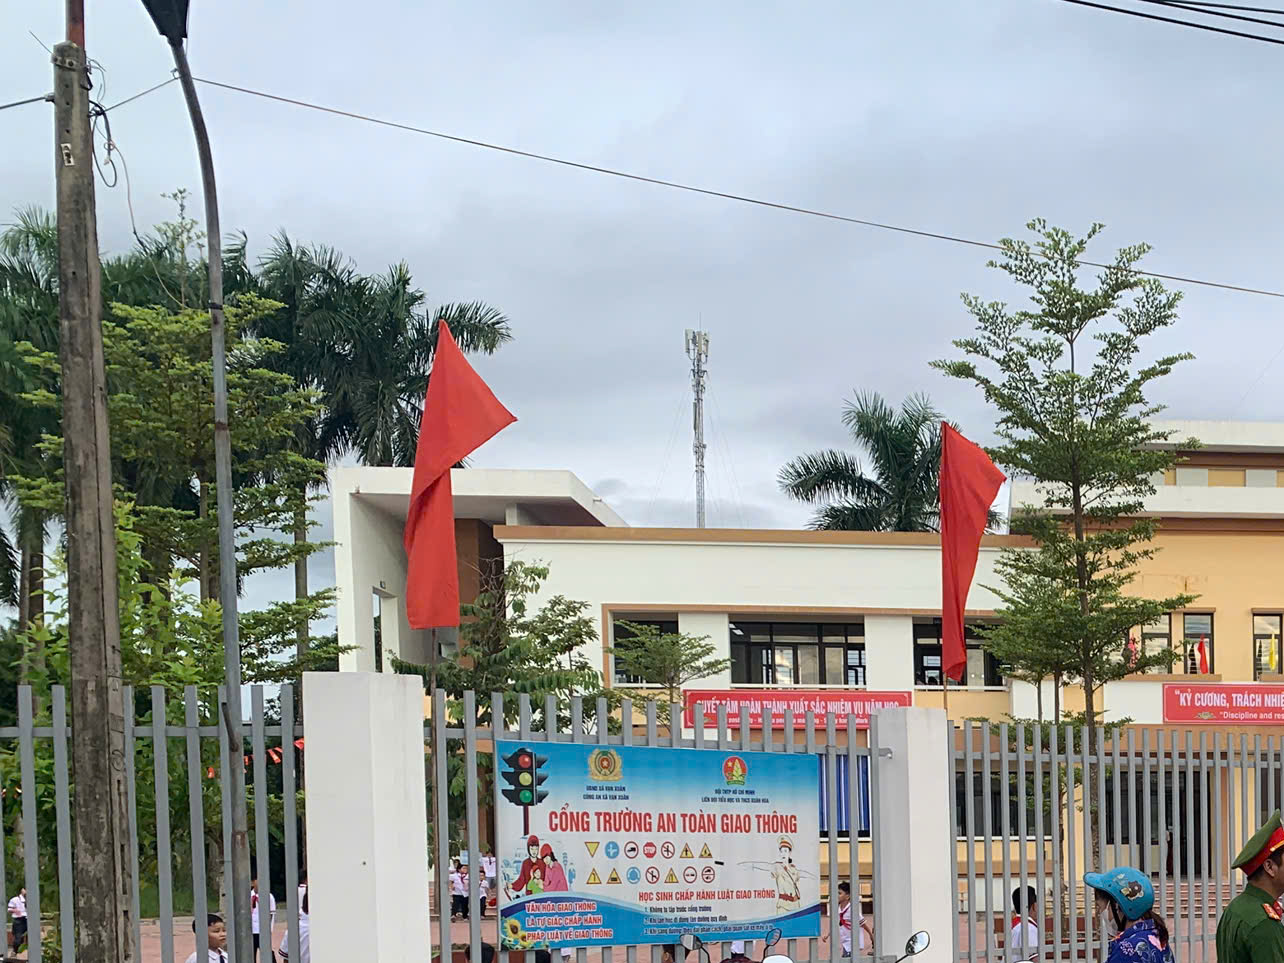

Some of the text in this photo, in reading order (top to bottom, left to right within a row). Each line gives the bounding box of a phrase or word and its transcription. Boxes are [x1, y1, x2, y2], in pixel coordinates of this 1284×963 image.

[810, 696, 825, 714] SẮC
[827, 698, 852, 717] NHIỆM
[1194, 693, 1230, 708] CƯƠNG,
[1231, 690, 1262, 707] TRÁCH
[549, 802, 798, 834] CỔNG TRƯỜNG AN TOÀN GIAO THÔNG
[639, 888, 776, 903] HỌC SINH CHẤP HÀNH LUẬT GIAO THÔNG
[557, 903, 573, 912] GIAO
[575, 900, 597, 912] THÔNG
[547, 915, 564, 926] GIÁC
[564, 913, 582, 926] CHẤP
[526, 930, 544, 941] PHÁP
[547, 929, 563, 942] LUẬT
[575, 930, 590, 939] GIAO
[591, 927, 613, 939] THÔNG
